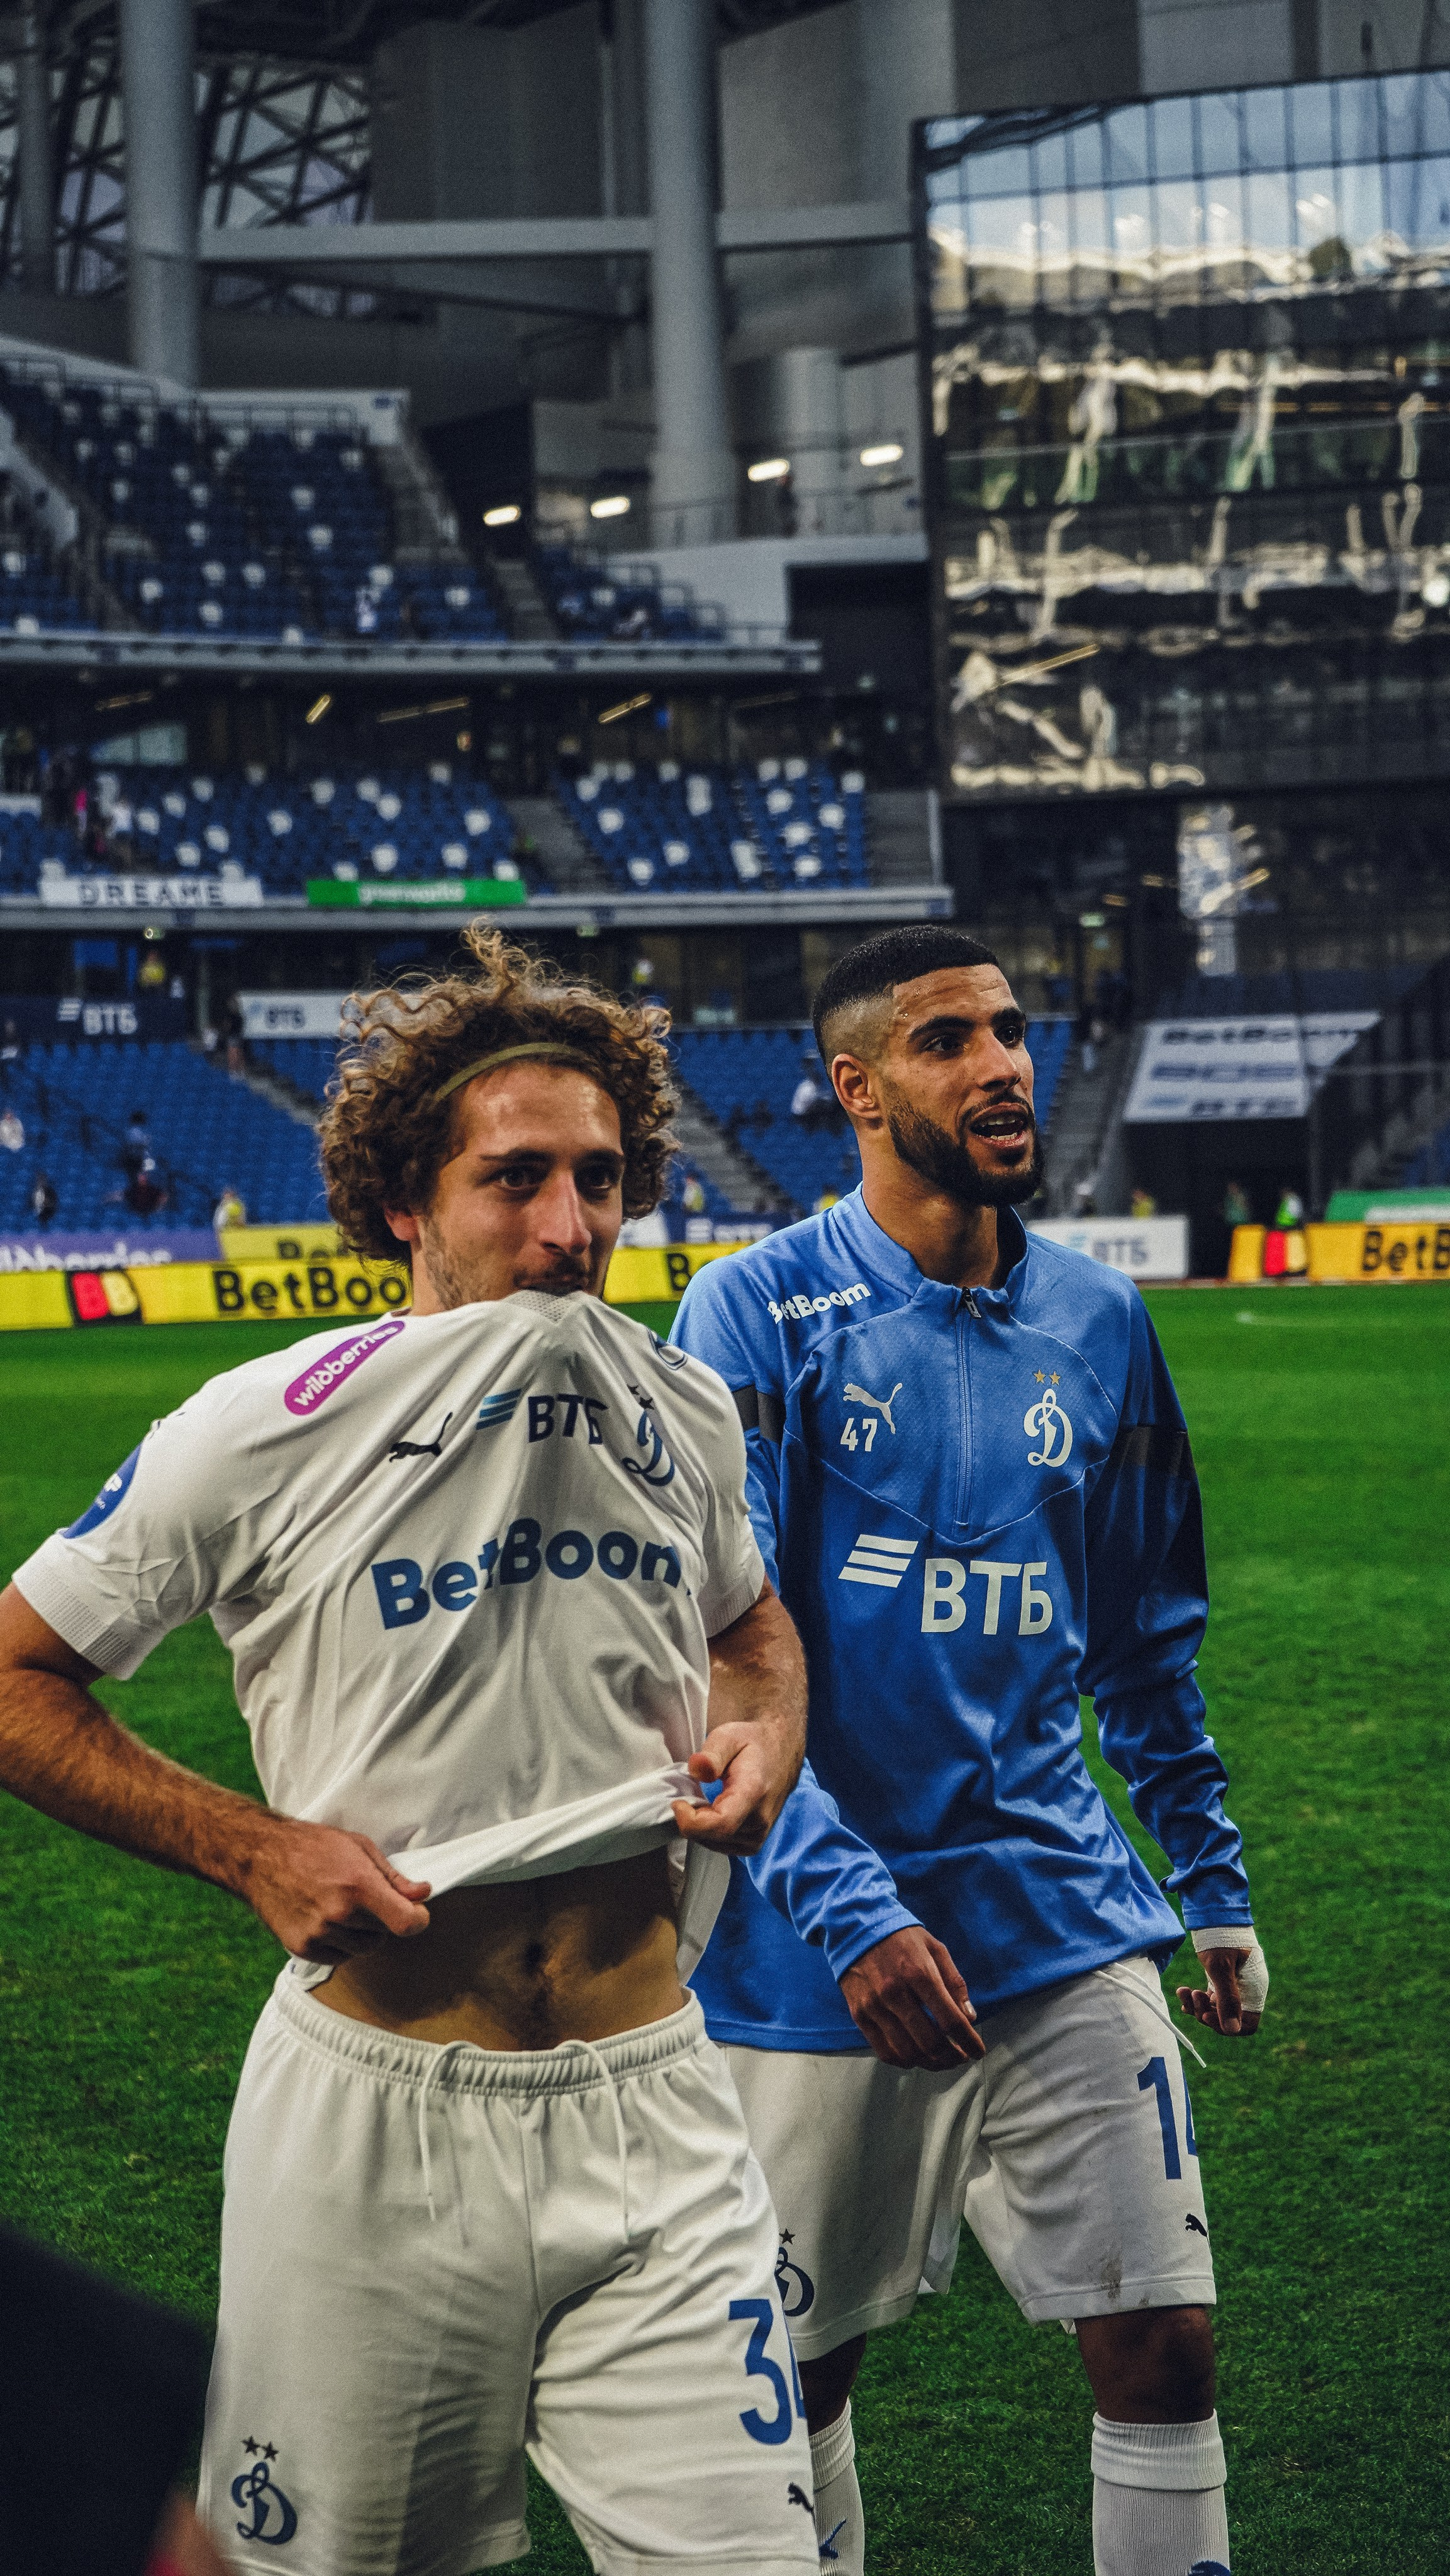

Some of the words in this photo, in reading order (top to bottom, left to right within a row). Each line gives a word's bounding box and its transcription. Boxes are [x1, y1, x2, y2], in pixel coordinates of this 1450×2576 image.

[79, 882, 223, 907] DREAME
[213, 1266, 407, 1311] BetBoo
[767, 1282, 871, 1324] BetBoom
[294, 1323, 399, 1407] wildberries
[527, 1394, 609, 1445] ВТБ
[840, 1417, 878, 1452] 47
[920, 1557, 1053, 1635] ВТБ
[1137, 2056, 1198, 2180] 1
[727, 2298, 807, 2446] 3
